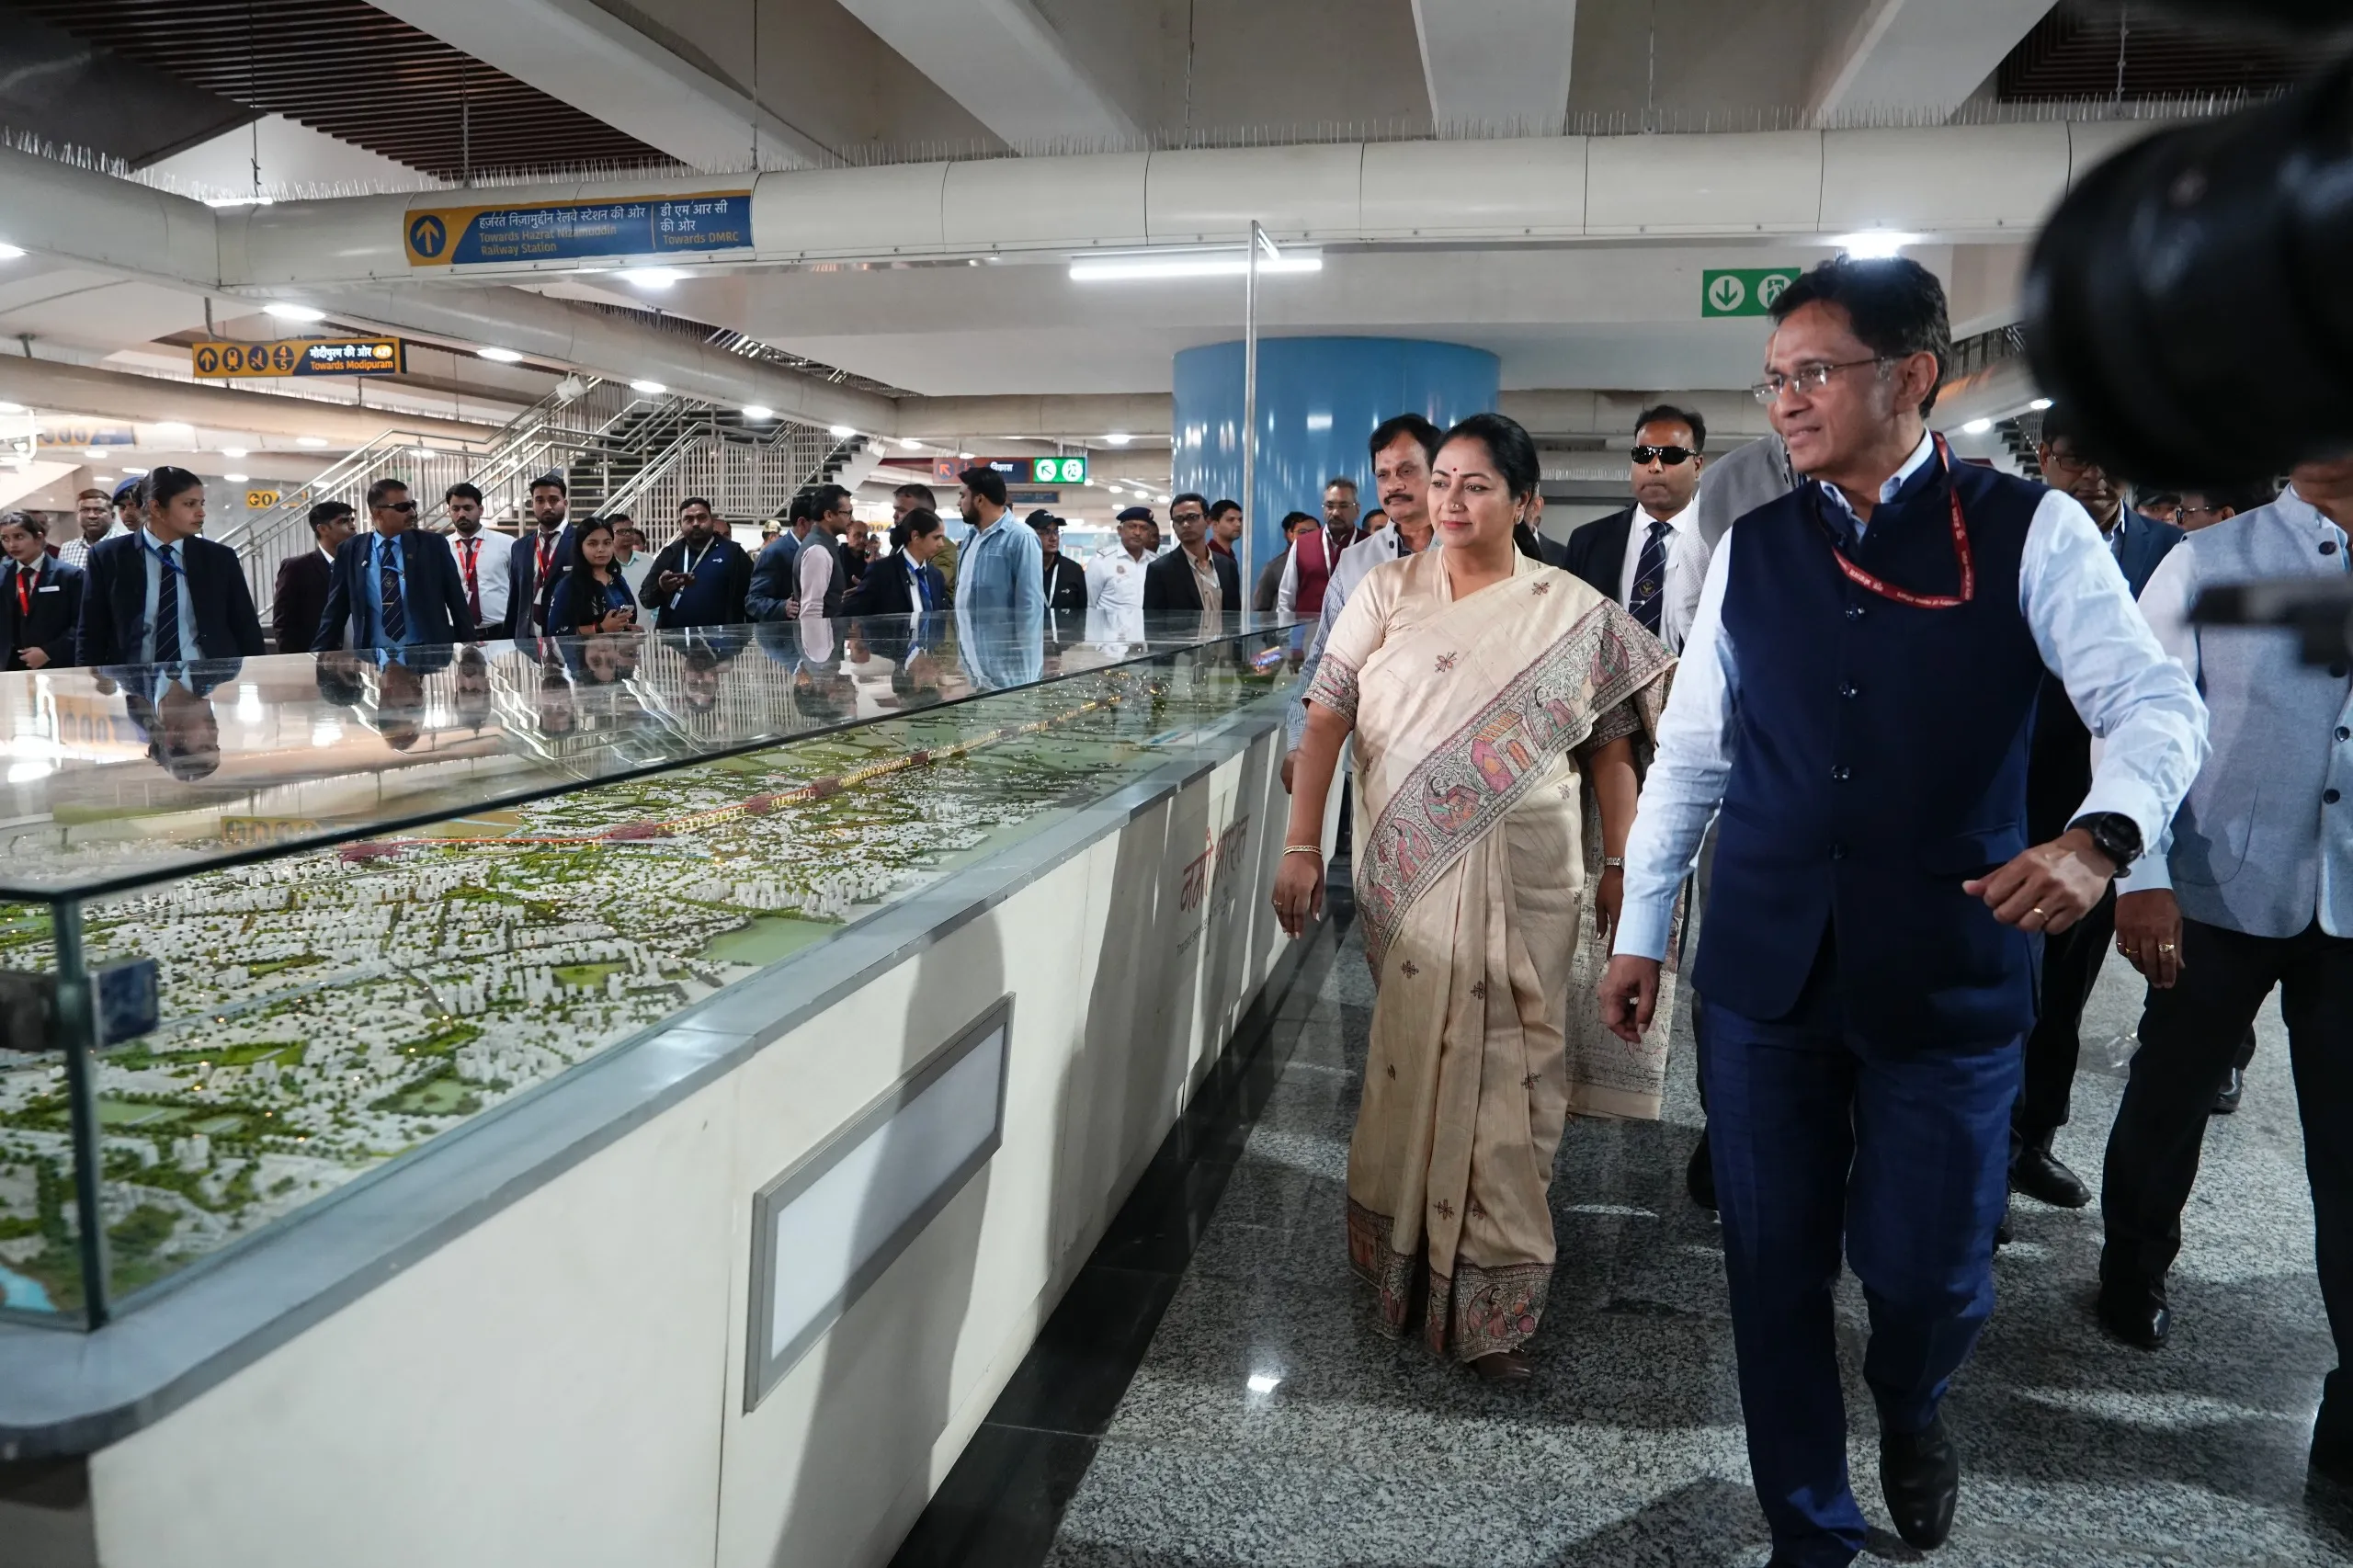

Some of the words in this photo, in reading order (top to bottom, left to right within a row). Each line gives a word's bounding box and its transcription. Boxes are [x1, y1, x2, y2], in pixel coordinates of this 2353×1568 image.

[660, 202, 672, 217] डी
[675, 204, 689, 217] एम
[693, 203, 712, 215] आर
[714, 199, 728, 214] सी
[509, 210, 553, 229] निज़ामुद्दीन
[556, 209, 578, 223] रेलवे
[580, 208, 608, 222] स्टेशन
[610, 205, 624, 220] की
[628, 204, 646, 219] ओर
[660, 218, 675, 233] की
[677, 217, 696, 232] ओर
[480, 232, 519, 243] Towards
[522, 229, 554, 241] Hazrat
[557, 224, 617, 239] Nizamuddin
[663, 233, 705, 245] Towards
[709, 231, 739, 243] DMRC
[481, 244, 518, 256] Railway
[521, 242, 557, 254] Station
[278, 346, 288, 357] 4
[309, 345, 342, 361] मोदीपुरम
[344, 344, 356, 358] की
[357, 345, 372, 358] ओर
[279, 359, 288, 370] 5
[311, 361, 344, 370] Towards
[347, 359, 393, 370] Modipuram
[1180, 826, 1214, 914] नमो
